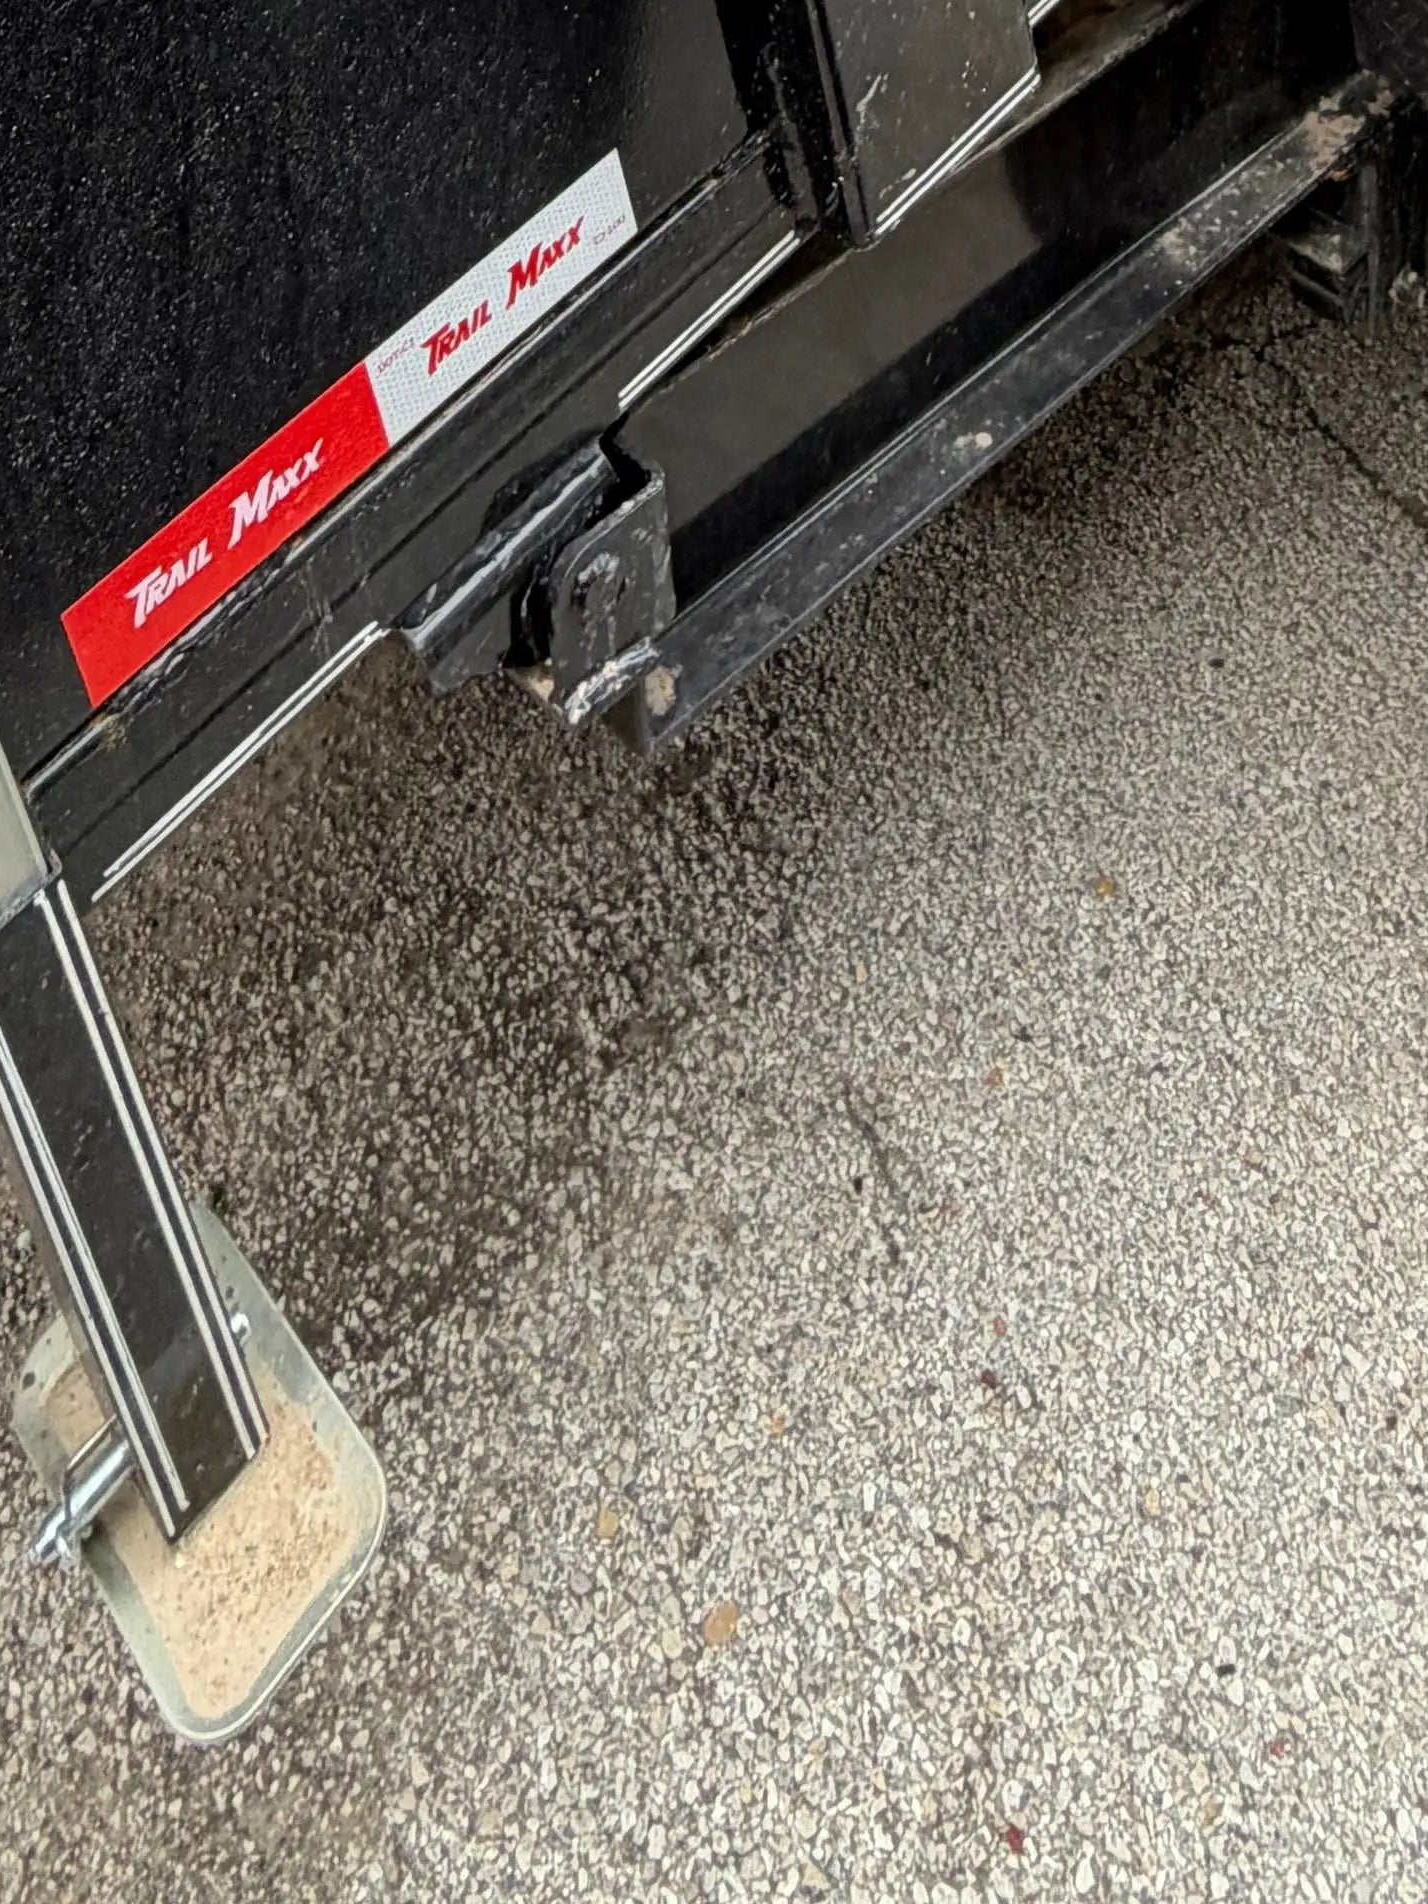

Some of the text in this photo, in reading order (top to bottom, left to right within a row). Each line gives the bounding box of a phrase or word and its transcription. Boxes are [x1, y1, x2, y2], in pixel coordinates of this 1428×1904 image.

[419, 215, 585, 376] TRAIL MAXX
[124, 436, 325, 629] TRAIL MAXX
